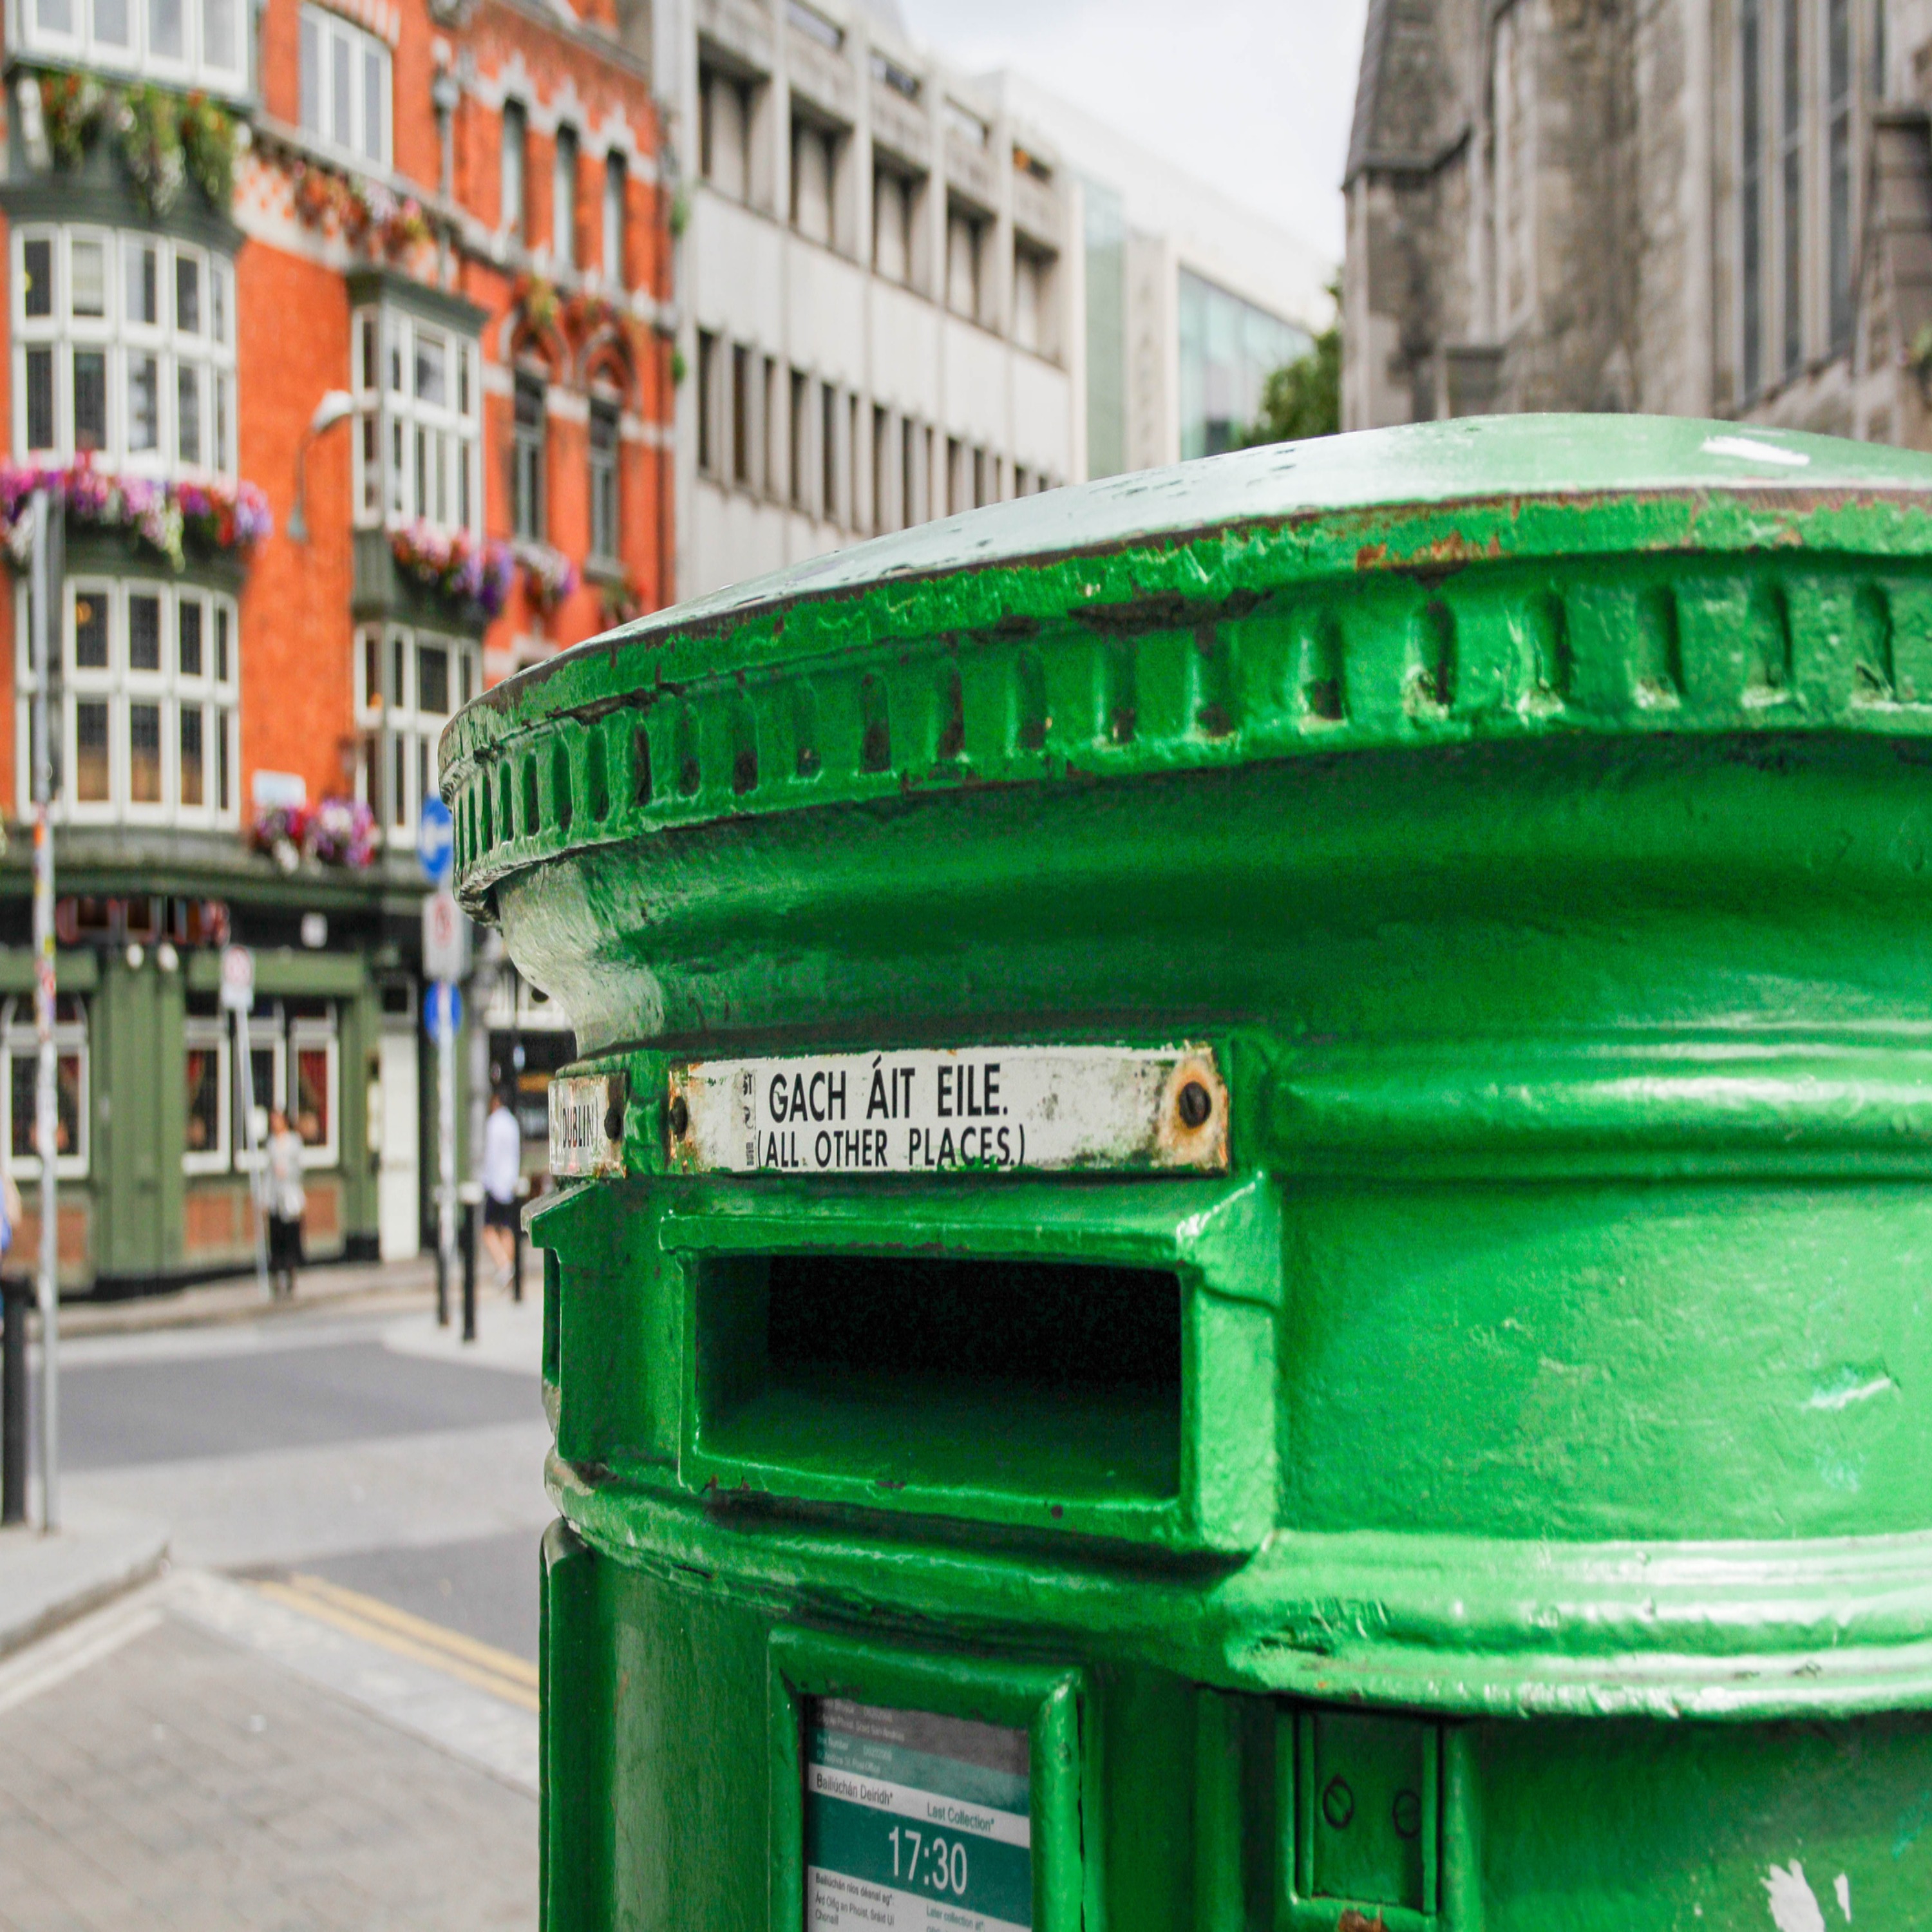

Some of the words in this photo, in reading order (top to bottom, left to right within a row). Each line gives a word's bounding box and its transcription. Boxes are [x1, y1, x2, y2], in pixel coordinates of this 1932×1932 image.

[770, 1071, 846, 1123] GACH
[866, 1054, 915, 1119] ÁIT
[938, 1063, 1008, 1117] EILE.
[757, 1130, 799, 1168] (ALL
[815, 1129, 888, 1168] OTHER
[909, 1124, 1025, 1167] PLACES.)
[927, 1802, 945, 1821] Last
[889, 1826, 967, 1895] 17:30
